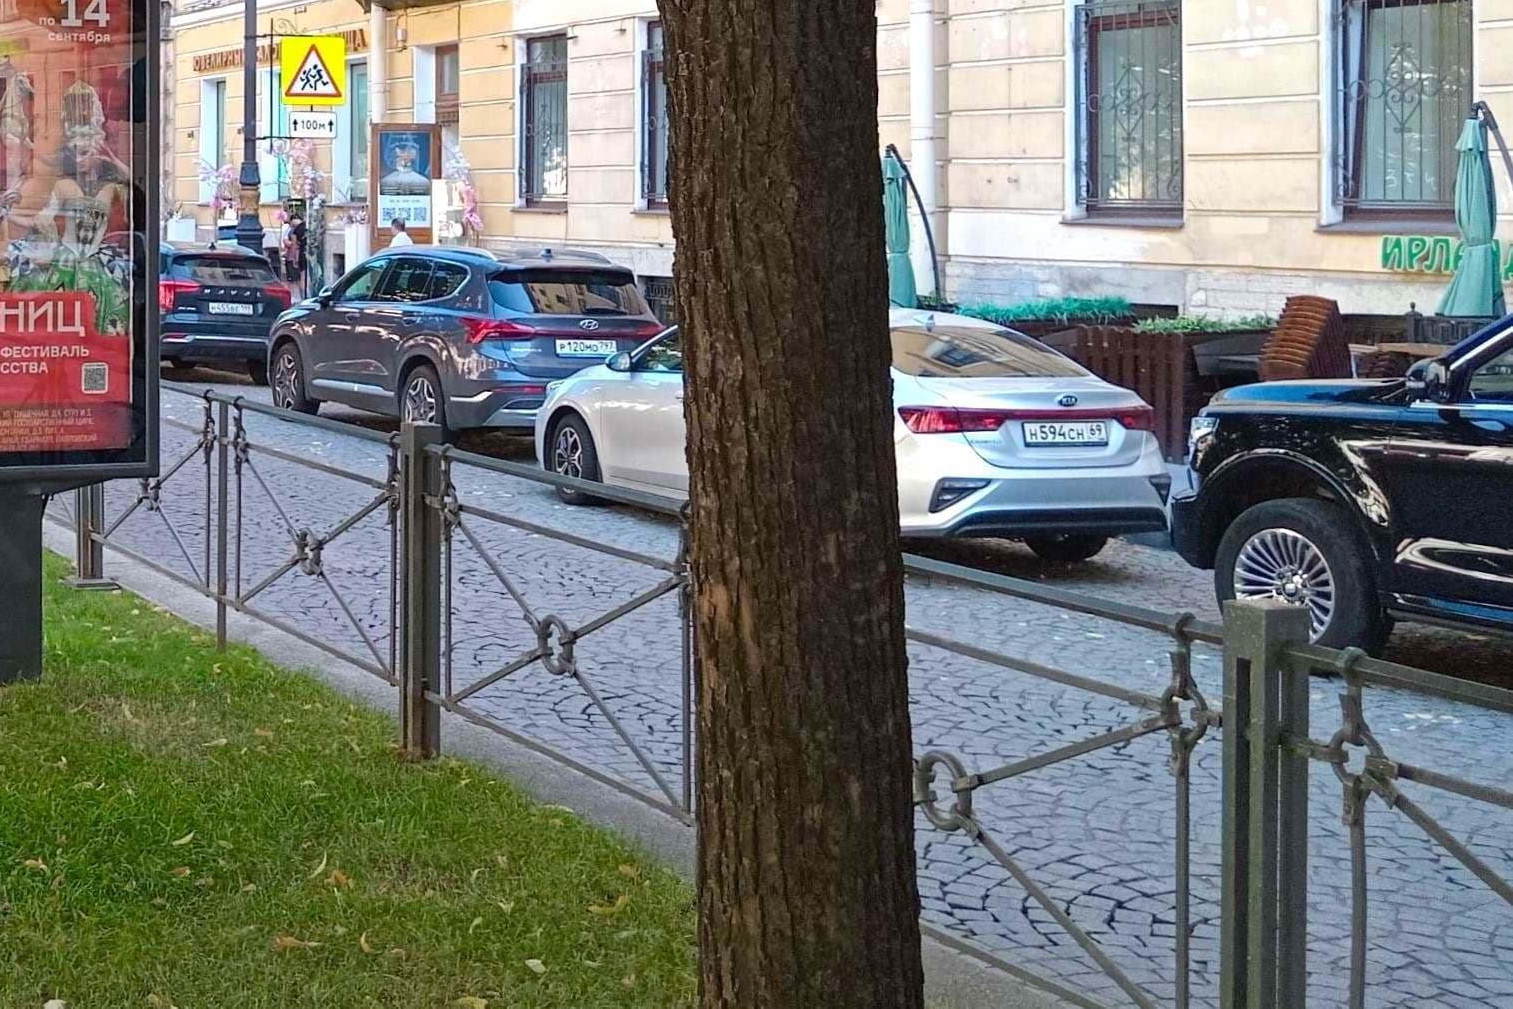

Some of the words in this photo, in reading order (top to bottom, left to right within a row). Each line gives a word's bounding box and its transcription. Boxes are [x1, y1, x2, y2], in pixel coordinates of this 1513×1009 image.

[39, 17, 55, 26] по
[48, 31, 111, 44] сентября
[193, 47, 245, 71] ЮВЕЛИРНЫ
[301, 120, 325, 130] 100м
[0, 345, 90, 358] ФЕСТИВАЛЬ
[1089, 424, 1102, 436] 69
